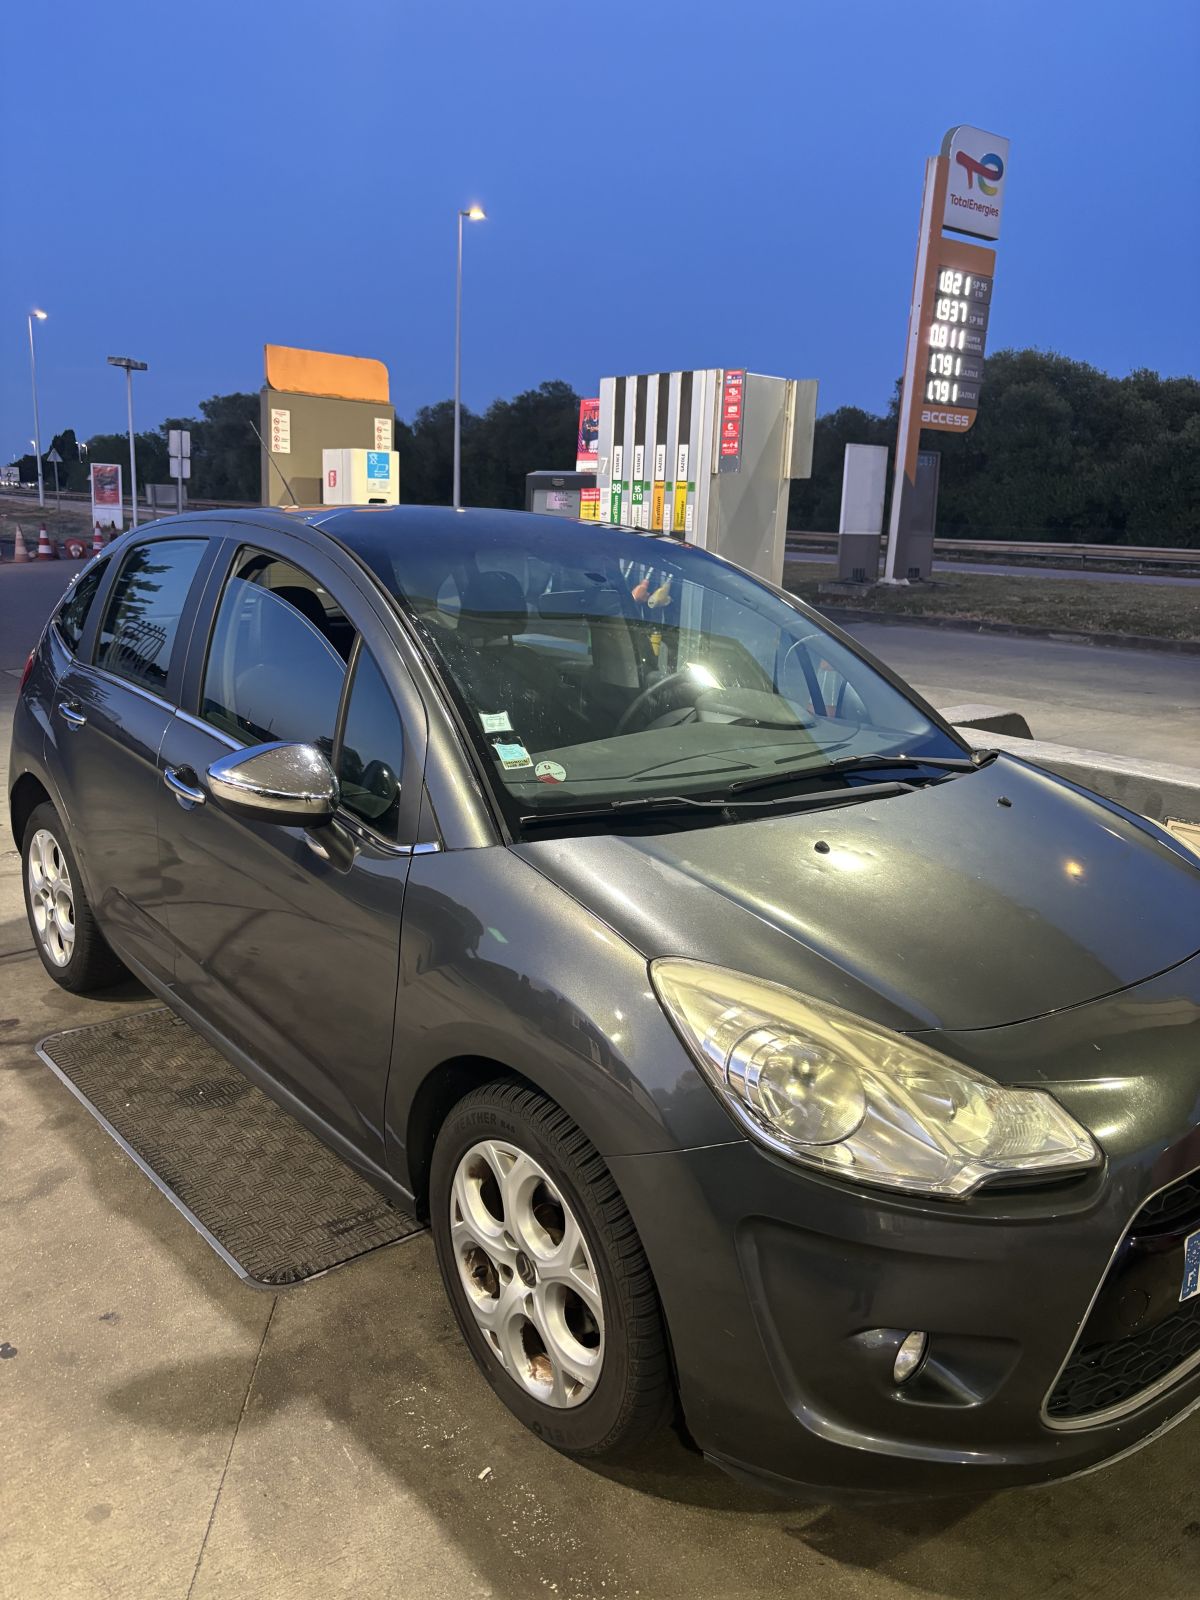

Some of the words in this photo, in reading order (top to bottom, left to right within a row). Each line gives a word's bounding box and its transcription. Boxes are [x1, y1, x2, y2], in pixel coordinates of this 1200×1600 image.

[950, 193, 999, 217] TotalEnergies
[601, 457, 608, 473] 7
[612, 483, 621, 494] 98
[634, 485, 642, 493] 95
[632, 493, 643, 501] E10
